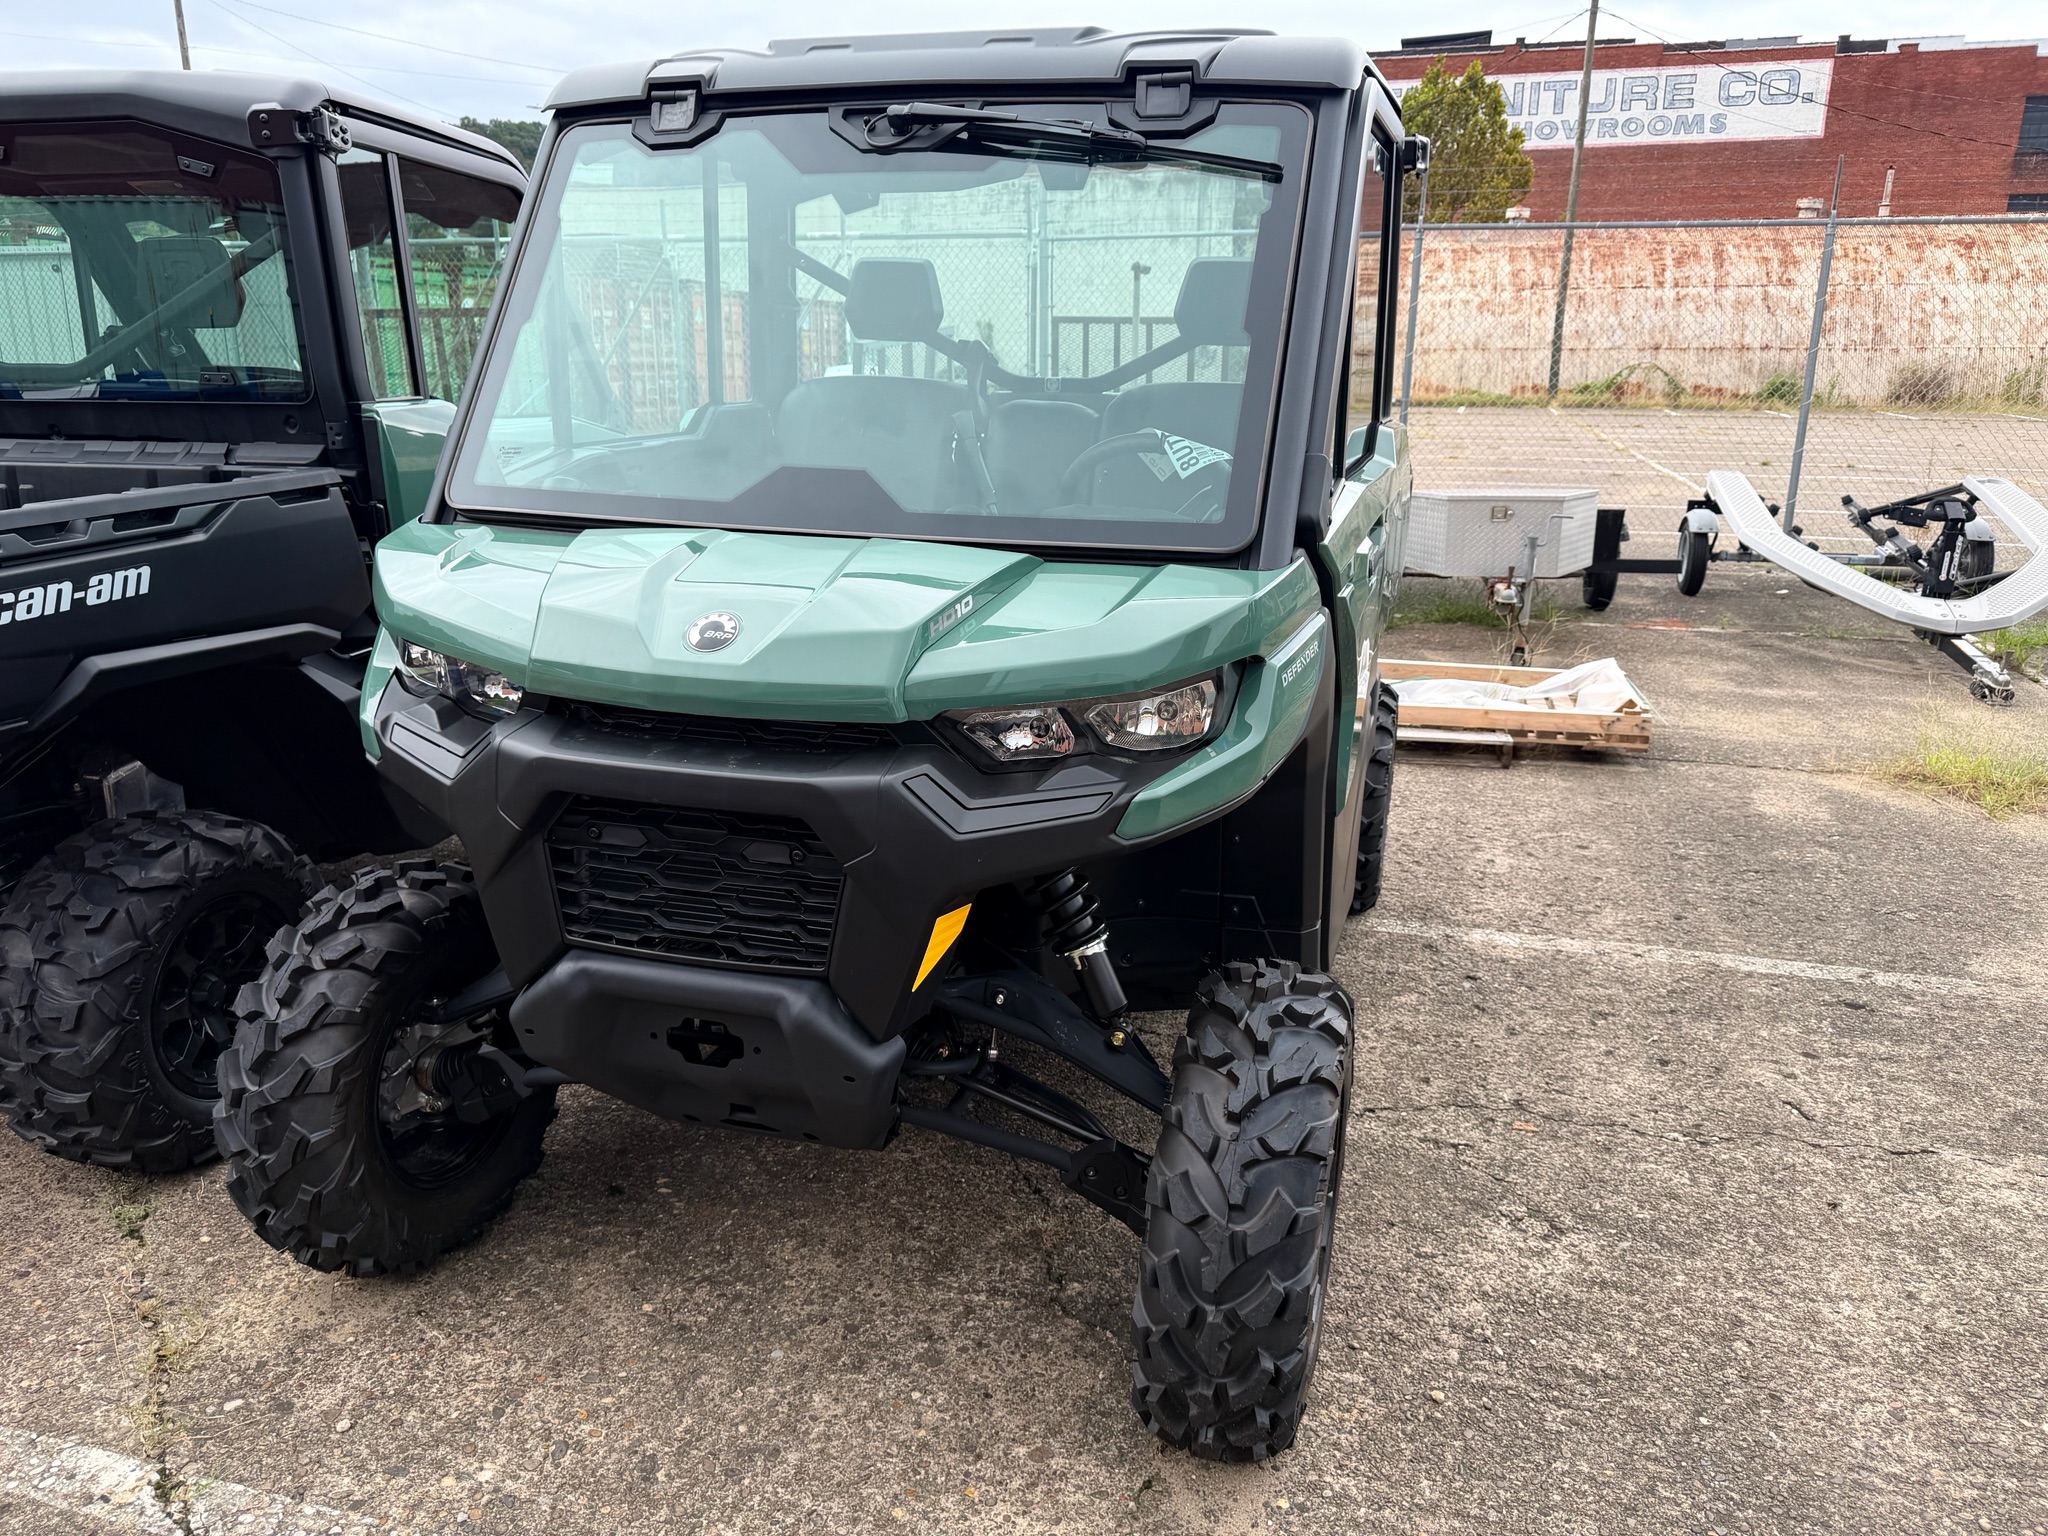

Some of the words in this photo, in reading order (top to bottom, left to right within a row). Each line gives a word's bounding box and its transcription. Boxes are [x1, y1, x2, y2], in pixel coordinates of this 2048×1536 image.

[1391, 74, 1698, 116] NITURE
[1719, 69, 1814, 107] CO.
[1512, 113, 1728, 141] HOWROOMS
[1161, 432, 1200, 472] 8UT
[0, 565, 151, 626] can-am
[929, 594, 973, 638] HD10
[703, 630, 734, 640] BRP
[1281, 640, 1320, 688] DEFENDER
